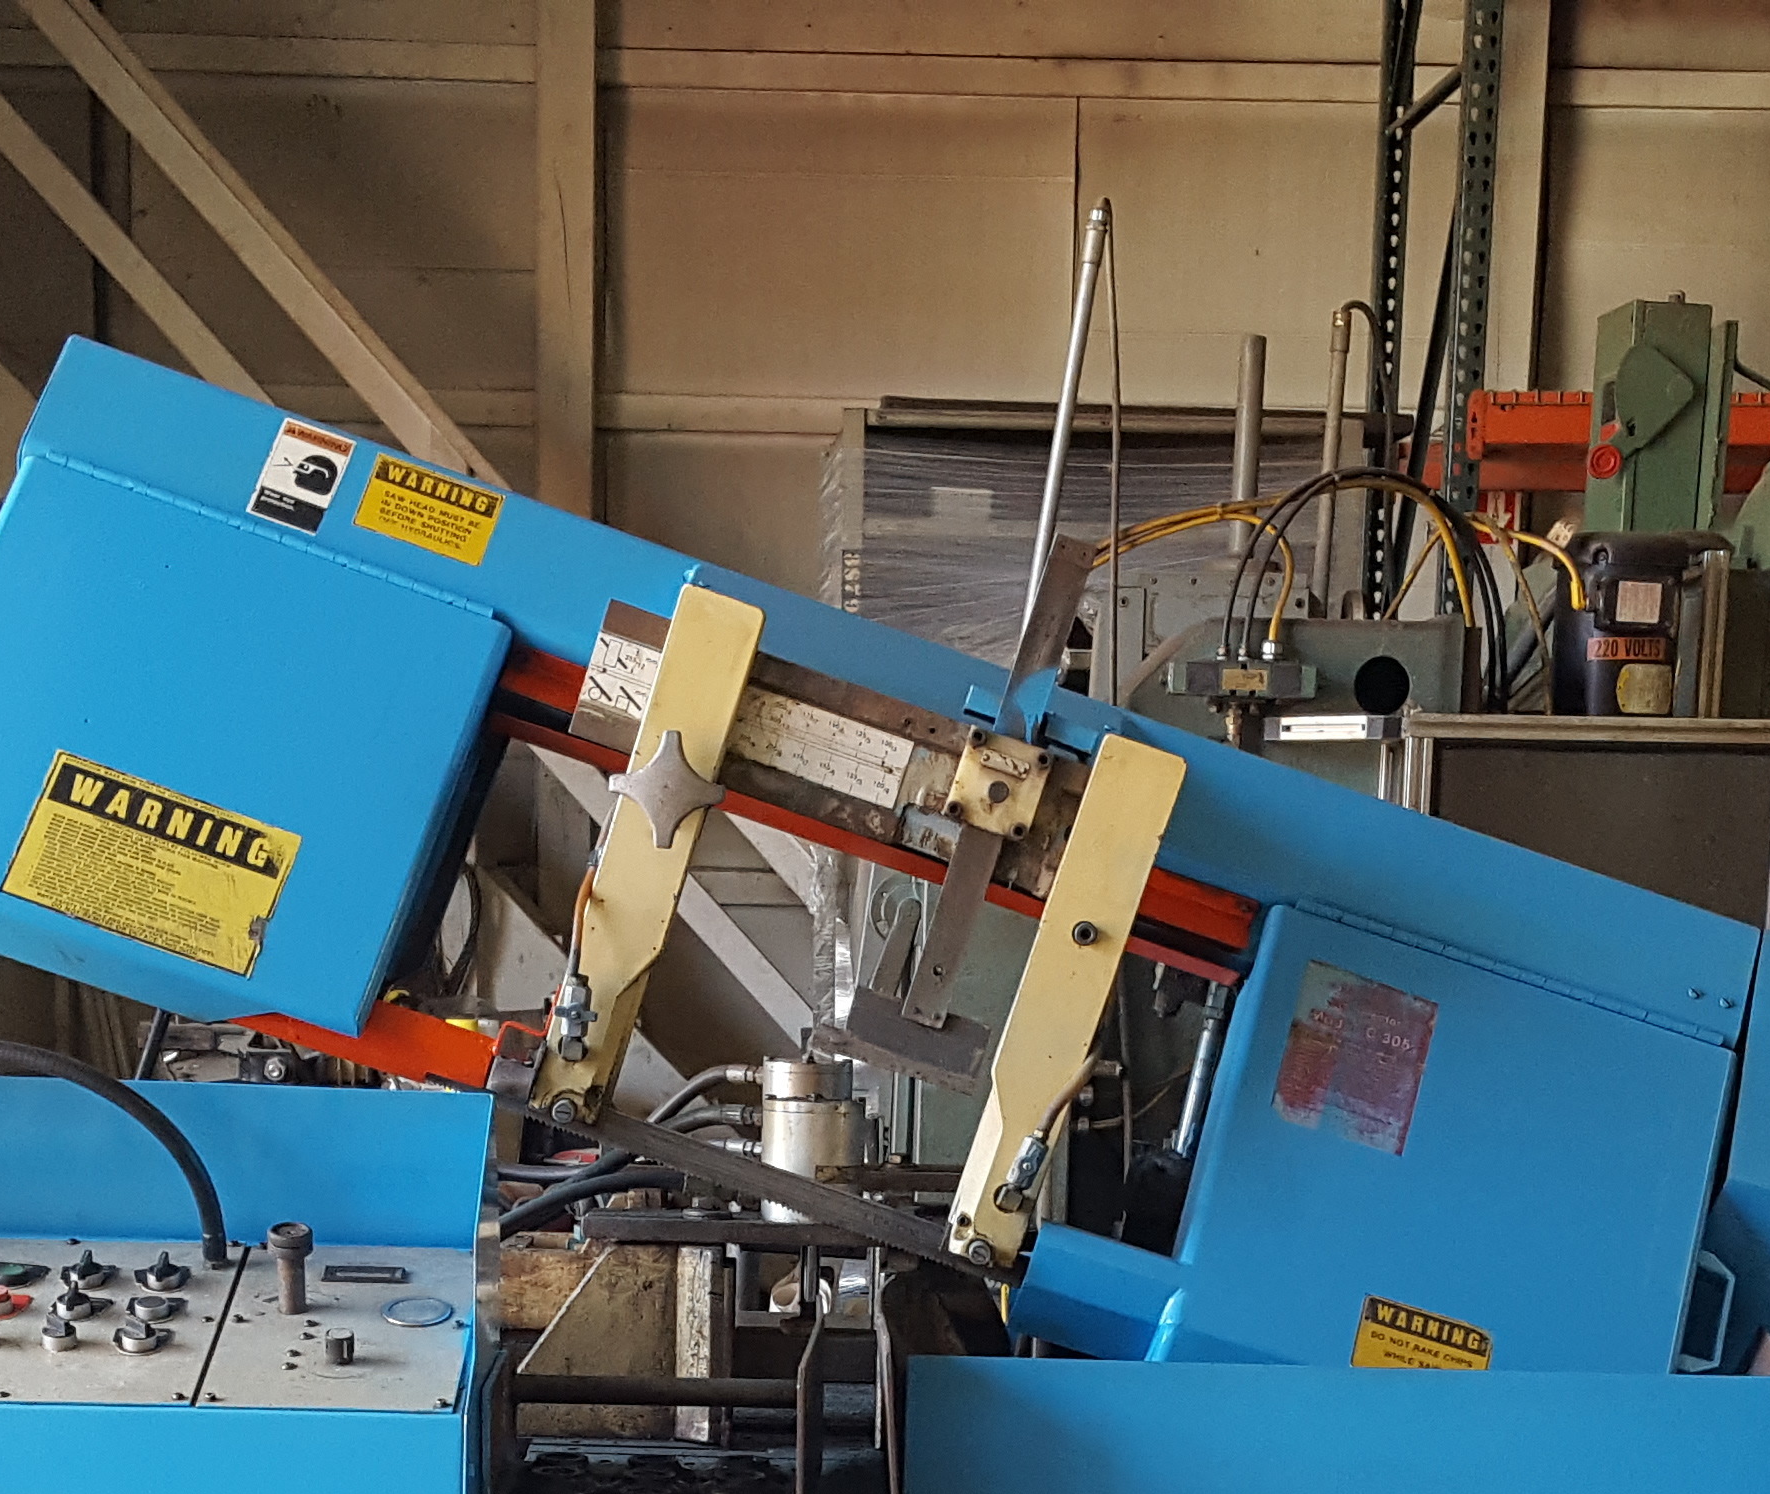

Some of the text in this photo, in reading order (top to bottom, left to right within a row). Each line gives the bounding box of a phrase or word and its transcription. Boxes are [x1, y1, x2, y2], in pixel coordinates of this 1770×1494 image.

[384, 463, 490, 513] WARNING
[383, 489, 406, 503] SAW
[408, 498, 435, 513] HEAD
[438, 509, 464, 523] MUST
[394, 502, 425, 518] DOWN
[426, 514, 472, 535] POSITION
[378, 506, 467, 542] BEFORE SHUTTING
[1595, 639, 1661, 657] 220 VOLTS
[65, 770, 274, 870] WARNING
[1381, 1031, 1411, 1051] 305
[1374, 1303, 1482, 1350] WARNING
[1370, 1330, 1473, 1368] DO NOT RAKE CHIPS
[1383, 1350, 1413, 1365] WHILE
